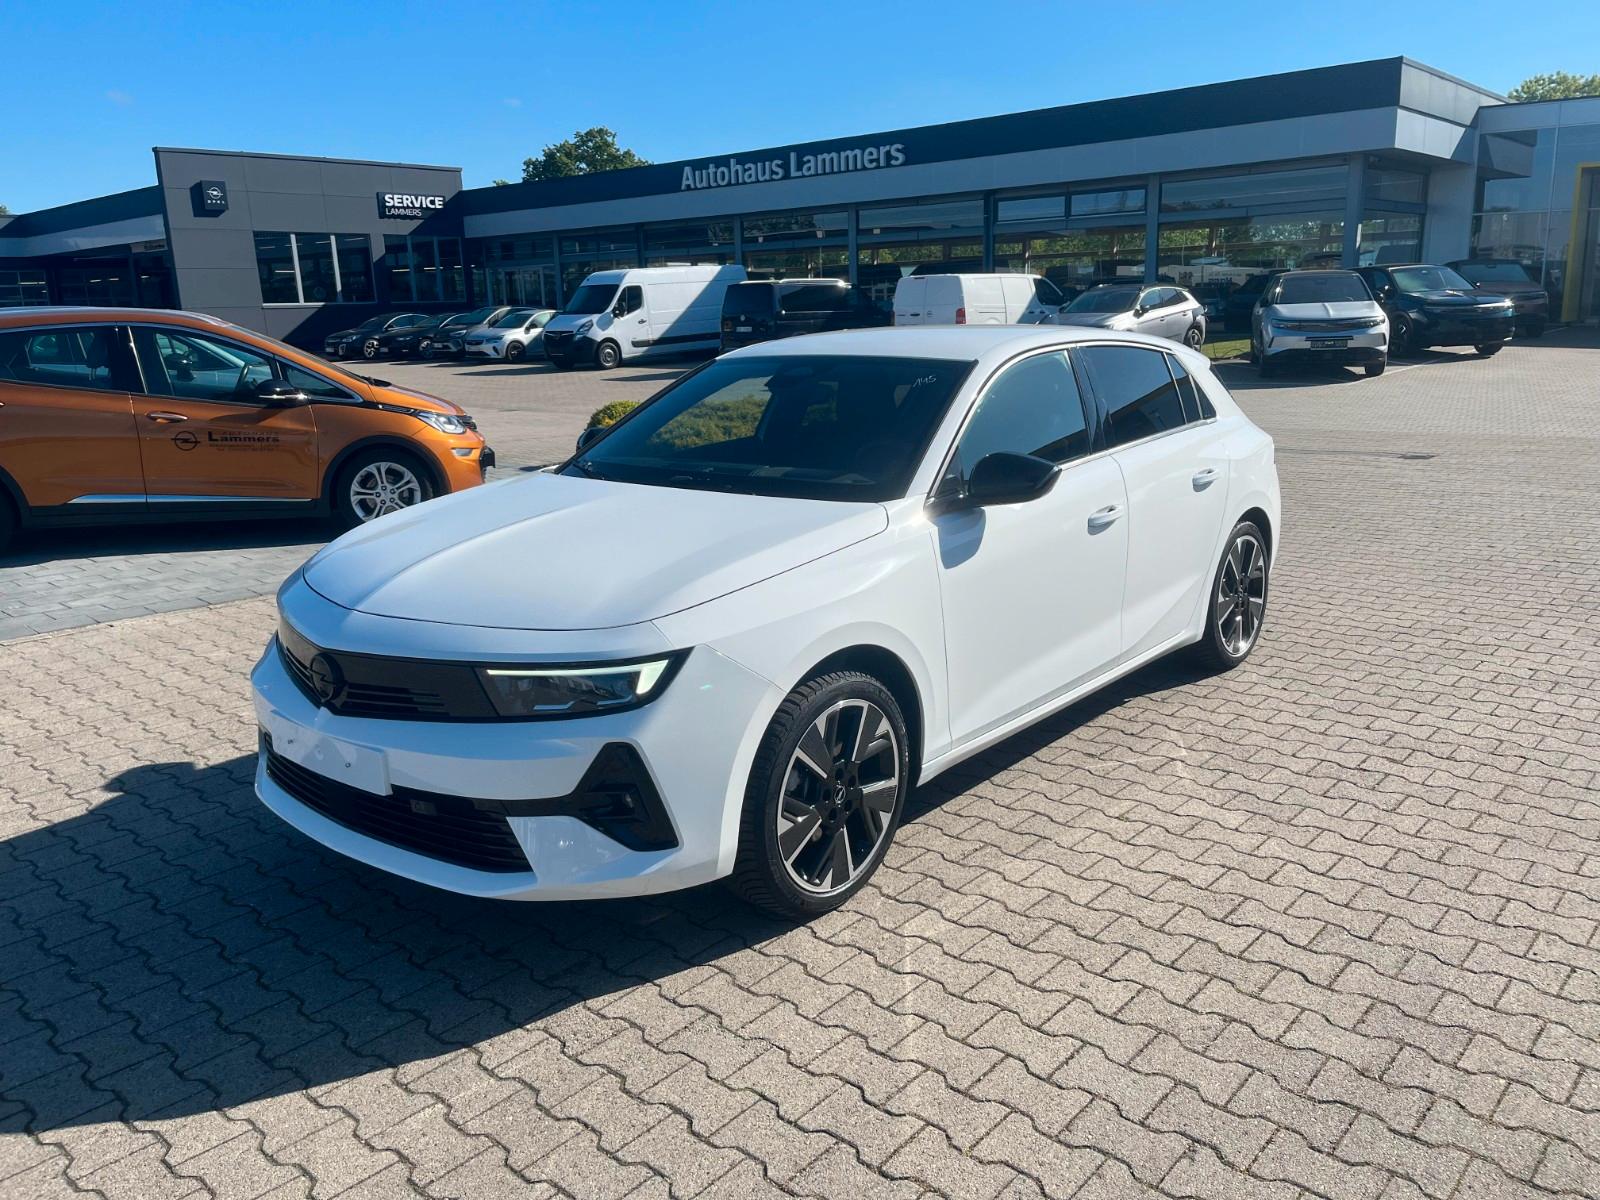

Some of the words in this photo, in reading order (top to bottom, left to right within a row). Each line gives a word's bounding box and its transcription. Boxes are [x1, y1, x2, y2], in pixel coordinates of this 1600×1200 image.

[680, 159, 785, 191] Autohaus
[789, 143, 906, 178] Lammers
[384, 193, 444, 209] SERVICE
[385, 207, 422, 217] LAMMERS
[207, 431, 280, 442] Lammers
